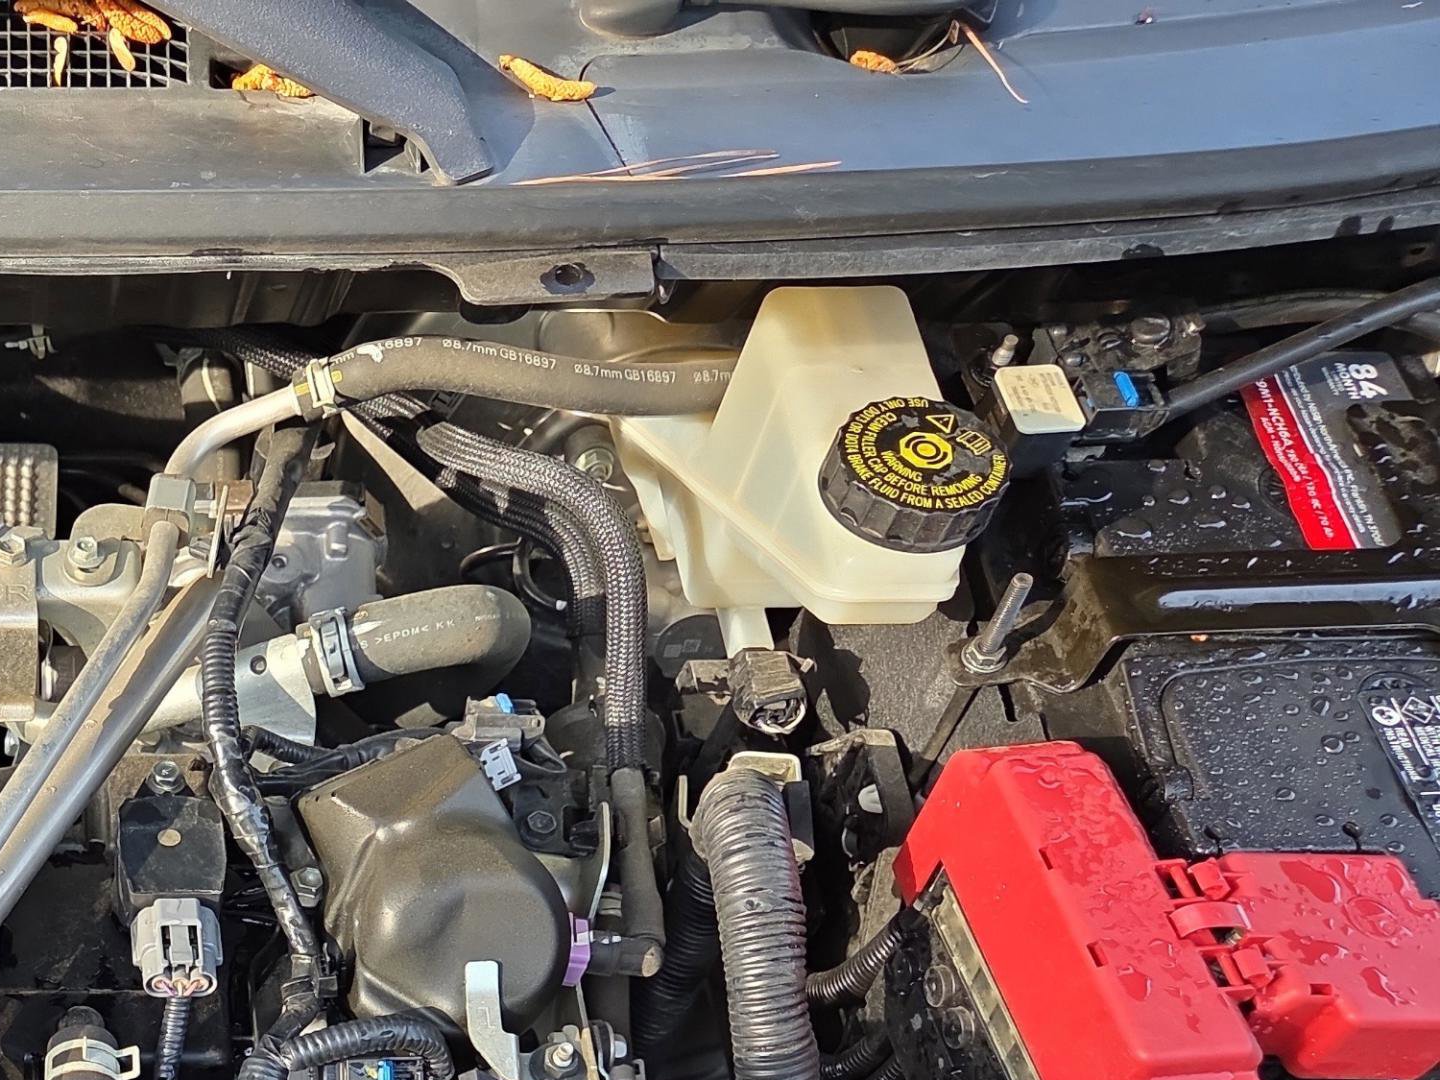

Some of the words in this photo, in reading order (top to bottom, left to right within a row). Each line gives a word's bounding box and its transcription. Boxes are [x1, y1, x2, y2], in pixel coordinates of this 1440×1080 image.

[499, 347, 557, 370] GB16897
[624, 368, 676, 383] GB16897
[1333, 362, 1362, 400] MONTH
[1348, 363, 1389, 399] 84
[855, 405, 881, 423] DOT3
[877, 398, 906, 412] ONLY
[907, 398, 929, 408] USE
[1255, 379, 1294, 446] 9M1-NCH6A
[847, 421, 864, 434] OR
[867, 412, 898, 433] CLEAN
[844, 433, 860, 453] DOT4
[861, 430, 878, 458] FILLER
[847, 453, 875, 481] BRAKE
[868, 457, 889, 474] CAP
[880, 450, 923, 482] WARNING
[979, 454, 1007, 495] CONTAINER
[868, 477, 900, 499] FLUID
[883, 472, 928, 496] BEFORE
[931, 473, 983, 497] REMOVING
[899, 492, 933, 508] FROM
[935, 498, 944, 509] A
[945, 490, 985, 509] SEALED
[1394, 726, 1413, 749] READ
